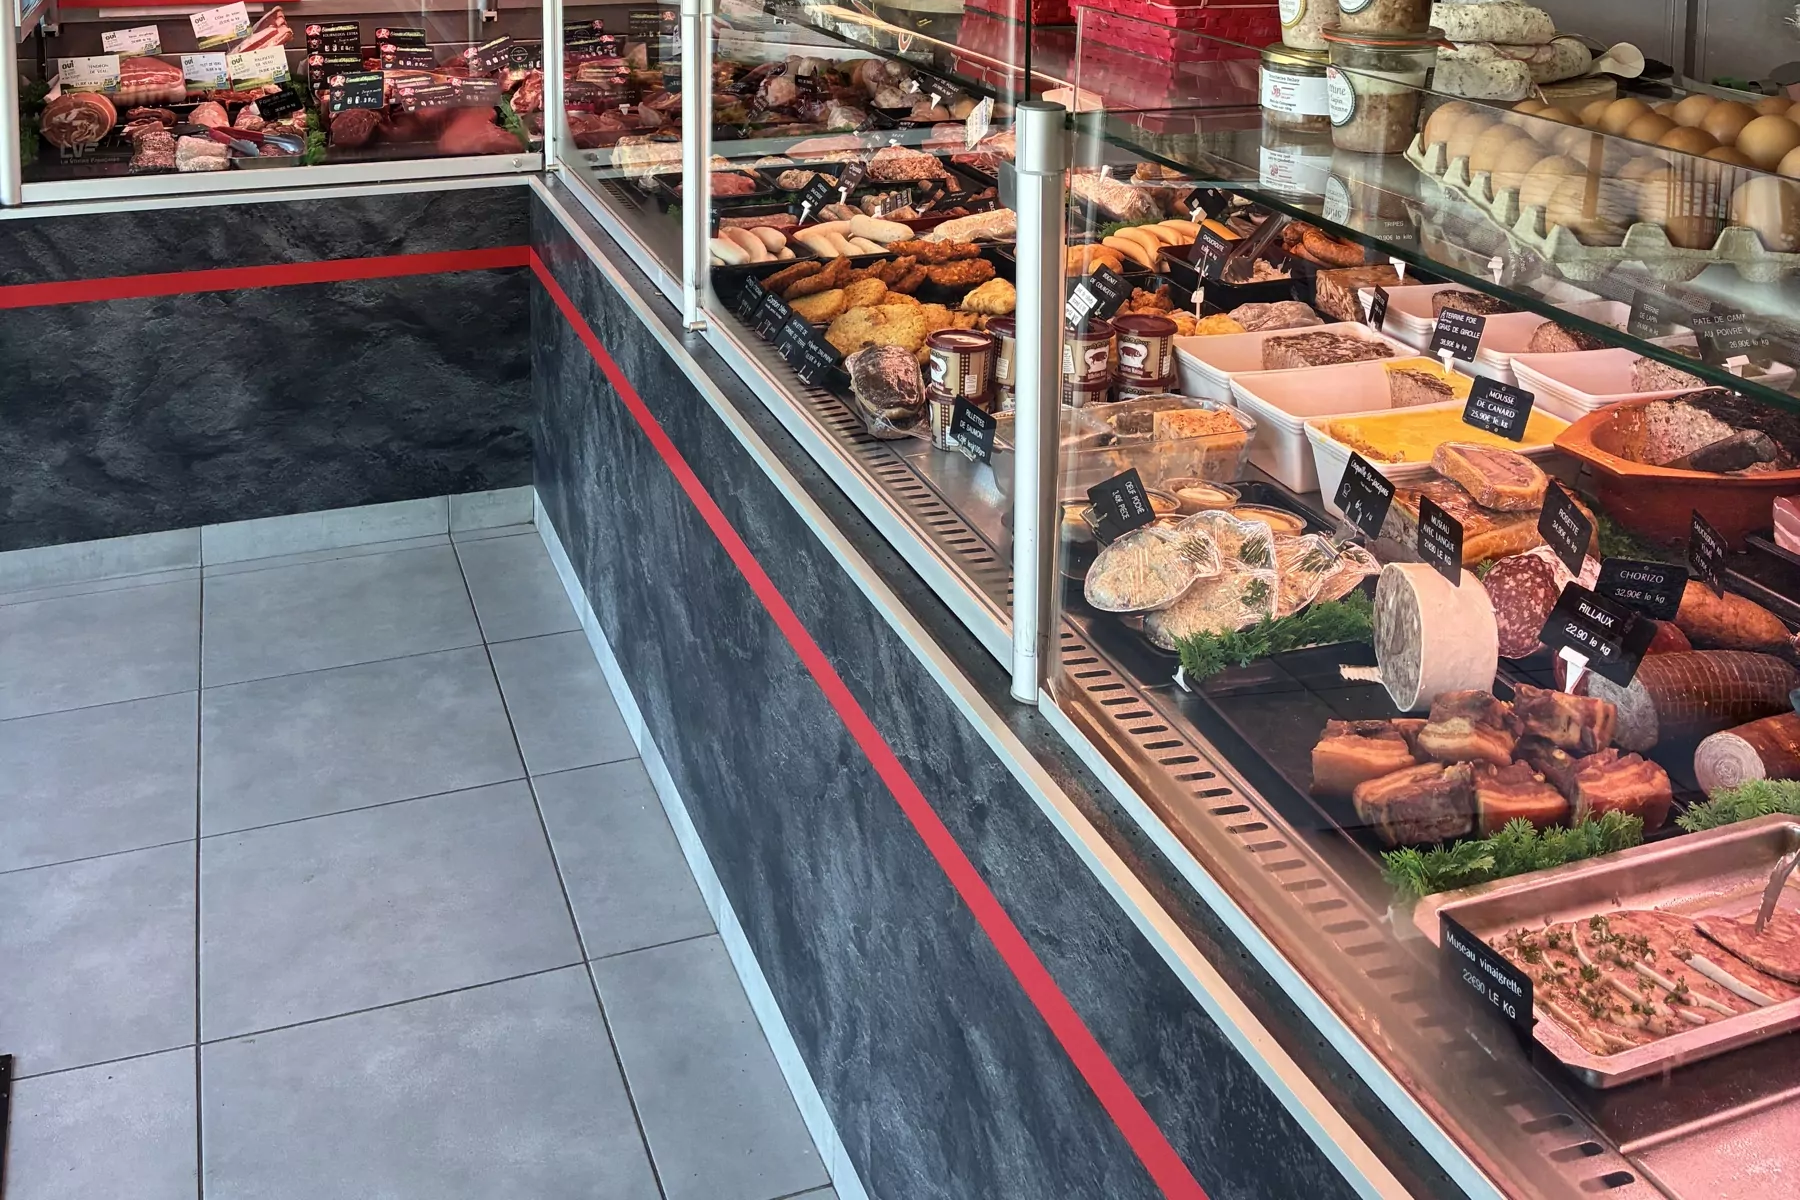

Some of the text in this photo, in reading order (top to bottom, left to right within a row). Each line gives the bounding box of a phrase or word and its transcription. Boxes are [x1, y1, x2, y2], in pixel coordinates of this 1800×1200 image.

[766, 294, 780, 309] Cordon
[1445, 312, 1477, 325] TERRINE FOIE
[1714, 315, 1724, 324] DE
[1438, 322, 1481, 339] GRAS DE GIROLLE
[1704, 330, 1714, 338] AU
[1716, 327, 1743, 338] POIVRE
[1761, 338, 1770, 346] kg
[1488, 390, 1515, 405] MOUSSE
[1476, 399, 1516, 419] DE CANARD
[959, 419, 966, 429] DE
[965, 408, 985, 428] RILLETTES
[1492, 414, 1499, 424] le
[1500, 419, 1509, 429] kg
[1430, 514, 1450, 535] MUSEAU
[1558, 507, 1580, 536] ROSETTE
[1422, 523, 1455, 553] AVEC LANGUE
[1570, 541, 1578, 554] kg
[1436, 548, 1443, 560] LE
[1444, 553, 1452, 566] KG
[1619, 570, 1664, 584] CHORIZO
[1644, 592, 1652, 601] le
[1655, 594, 1666, 604] kg
[1578, 602, 1615, 628] RILLAUX
[1565, 622, 1611, 656] 22,90 le kg
[1446, 931, 1523, 997] Museau vinaigrette
[1462, 968, 1516, 1019] 22€90 LE KG
